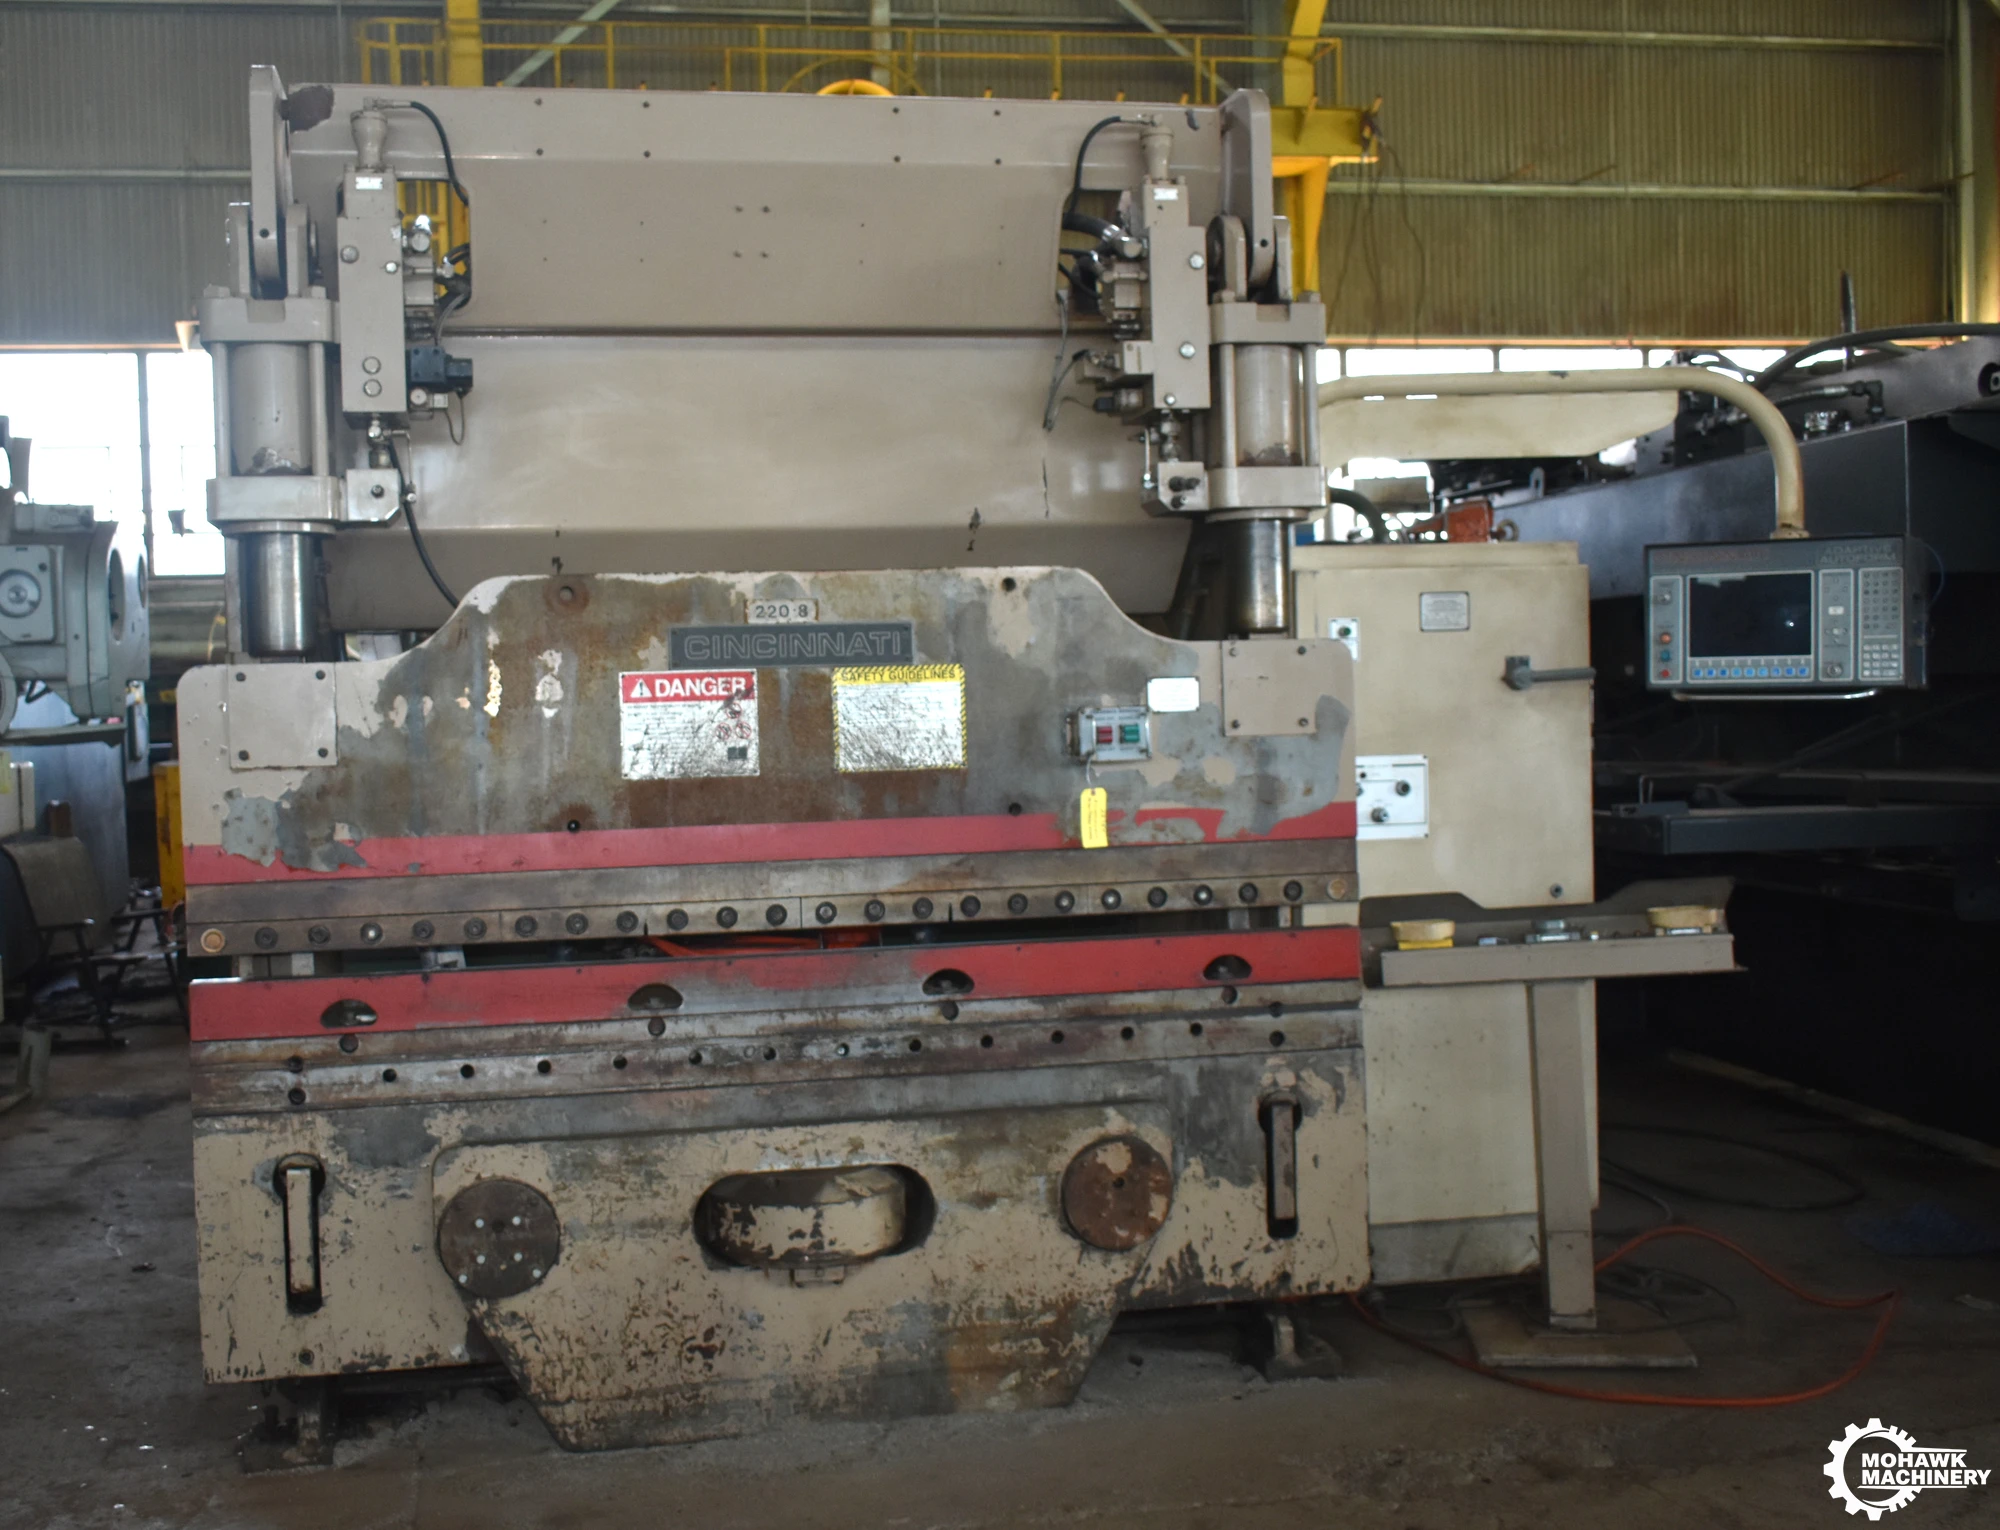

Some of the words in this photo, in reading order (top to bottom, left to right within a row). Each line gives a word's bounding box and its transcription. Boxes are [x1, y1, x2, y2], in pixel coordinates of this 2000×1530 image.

[684, 631, 900, 660] CINCINNATI
[841, 671, 885, 682] SAFETY
[888, 669, 956, 681] GUIDELINES
[654, 676, 747, 698] DANGER
